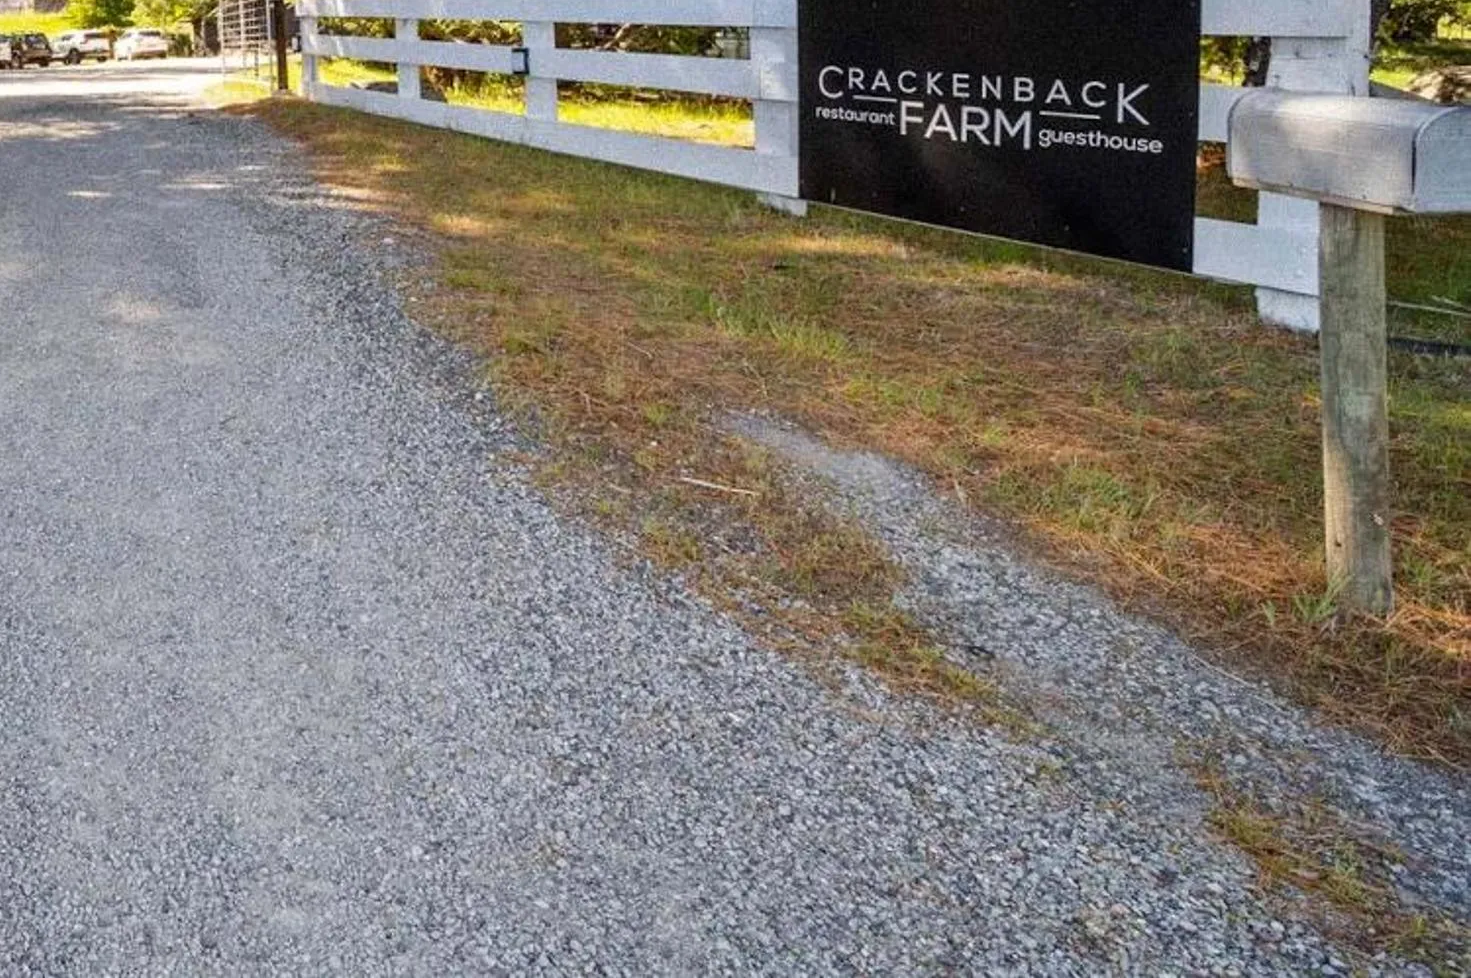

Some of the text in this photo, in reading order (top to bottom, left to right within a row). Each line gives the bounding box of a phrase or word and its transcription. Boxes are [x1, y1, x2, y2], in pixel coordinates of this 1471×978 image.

[818, 65, 1151, 126] CRACKENBACK
[815, 100, 1163, 154] restaurant FARM guesthouse
